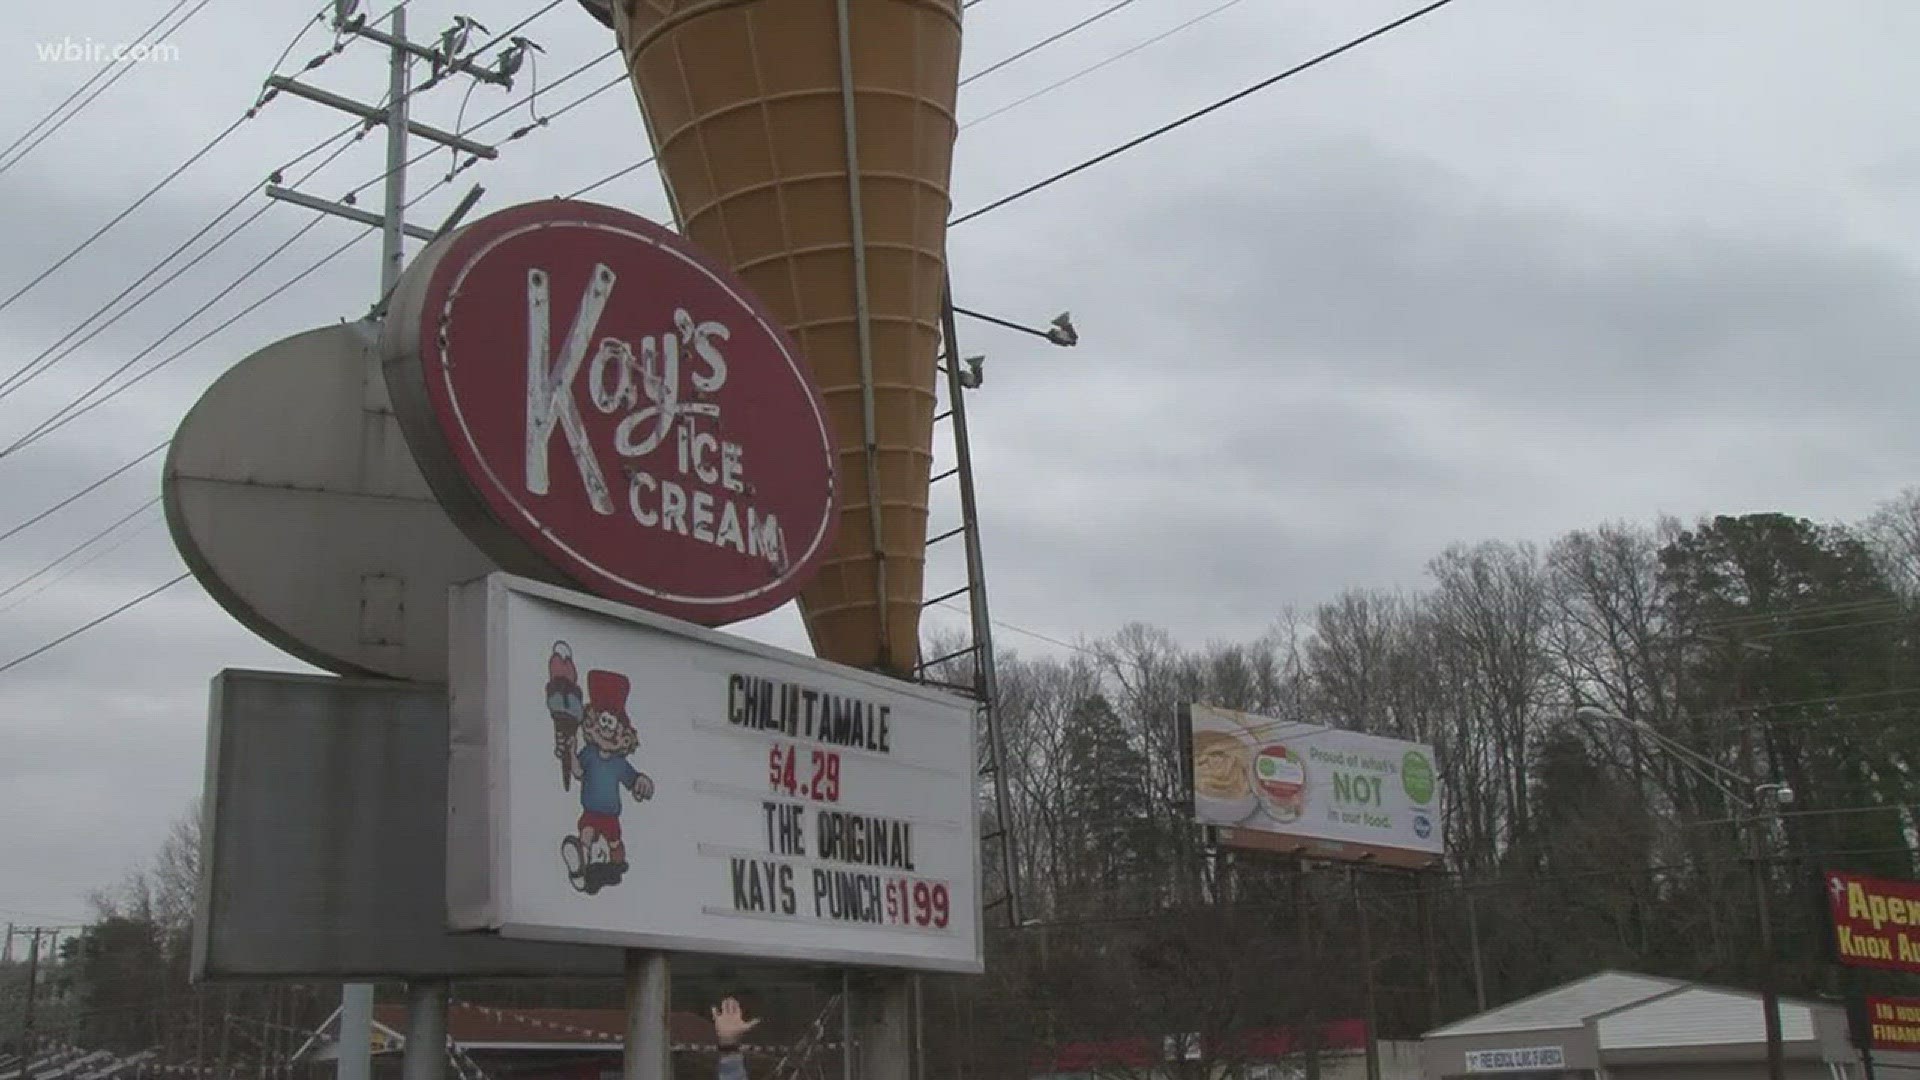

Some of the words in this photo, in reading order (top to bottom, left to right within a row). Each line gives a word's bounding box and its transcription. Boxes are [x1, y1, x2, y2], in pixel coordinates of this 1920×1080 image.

[526, 262, 731, 515] Kay's
[678, 420, 745, 492] ICE
[629, 472, 782, 564] CREAM
[769, 744, 840, 802] $4.29
[1310, 747, 1345, 766] Proud
[1346, 754, 1358, 768] of
[1333, 771, 1382, 806] NOT
[763, 802, 805, 856] THE
[817, 810, 915, 871] ORIGINAL
[1342, 813, 1361, 825] our
[731, 858, 796, 915] KAYS
[813, 868, 883, 925] PUNCH
[1838, 925, 1893, 961] Knox
